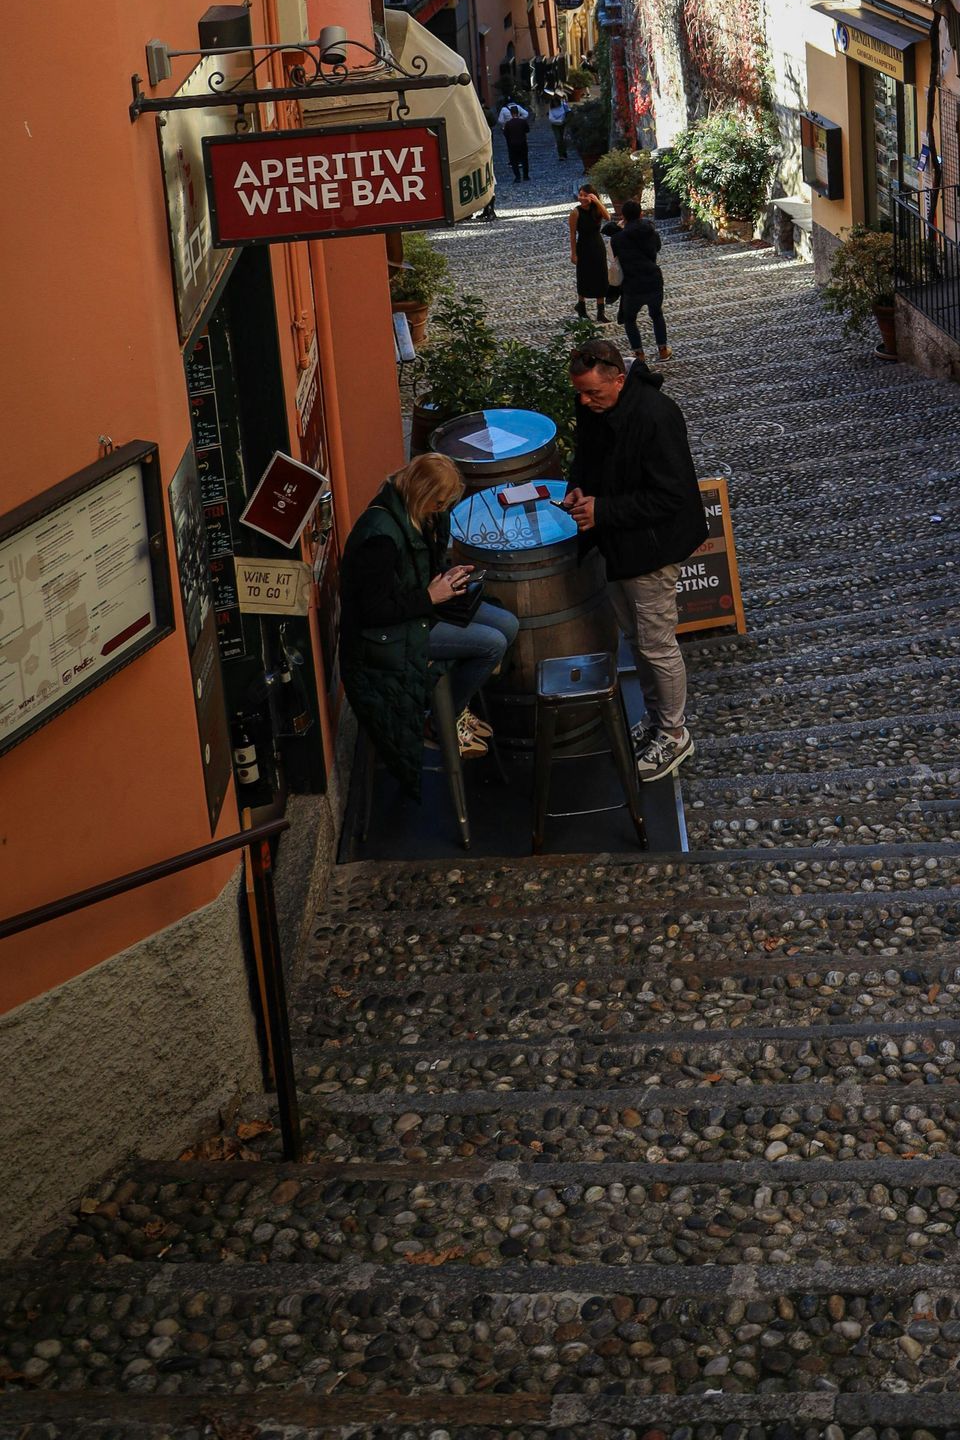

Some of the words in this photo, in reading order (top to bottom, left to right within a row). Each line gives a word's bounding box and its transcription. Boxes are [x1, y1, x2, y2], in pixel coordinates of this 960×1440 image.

[233, 146, 426, 188] APERITIVI
[458, 162, 494, 206] BILA
[237, 182, 341, 216] WINE
[351, 175, 426, 207] BAR
[680, 563, 706, 578] INE
[247, 585, 261, 596] TO
[266, 587, 281, 599] GO
[675, 575, 719, 593] STING
[73, 656, 94, 675] FedEx
[18, 694, 35, 710] WINE
